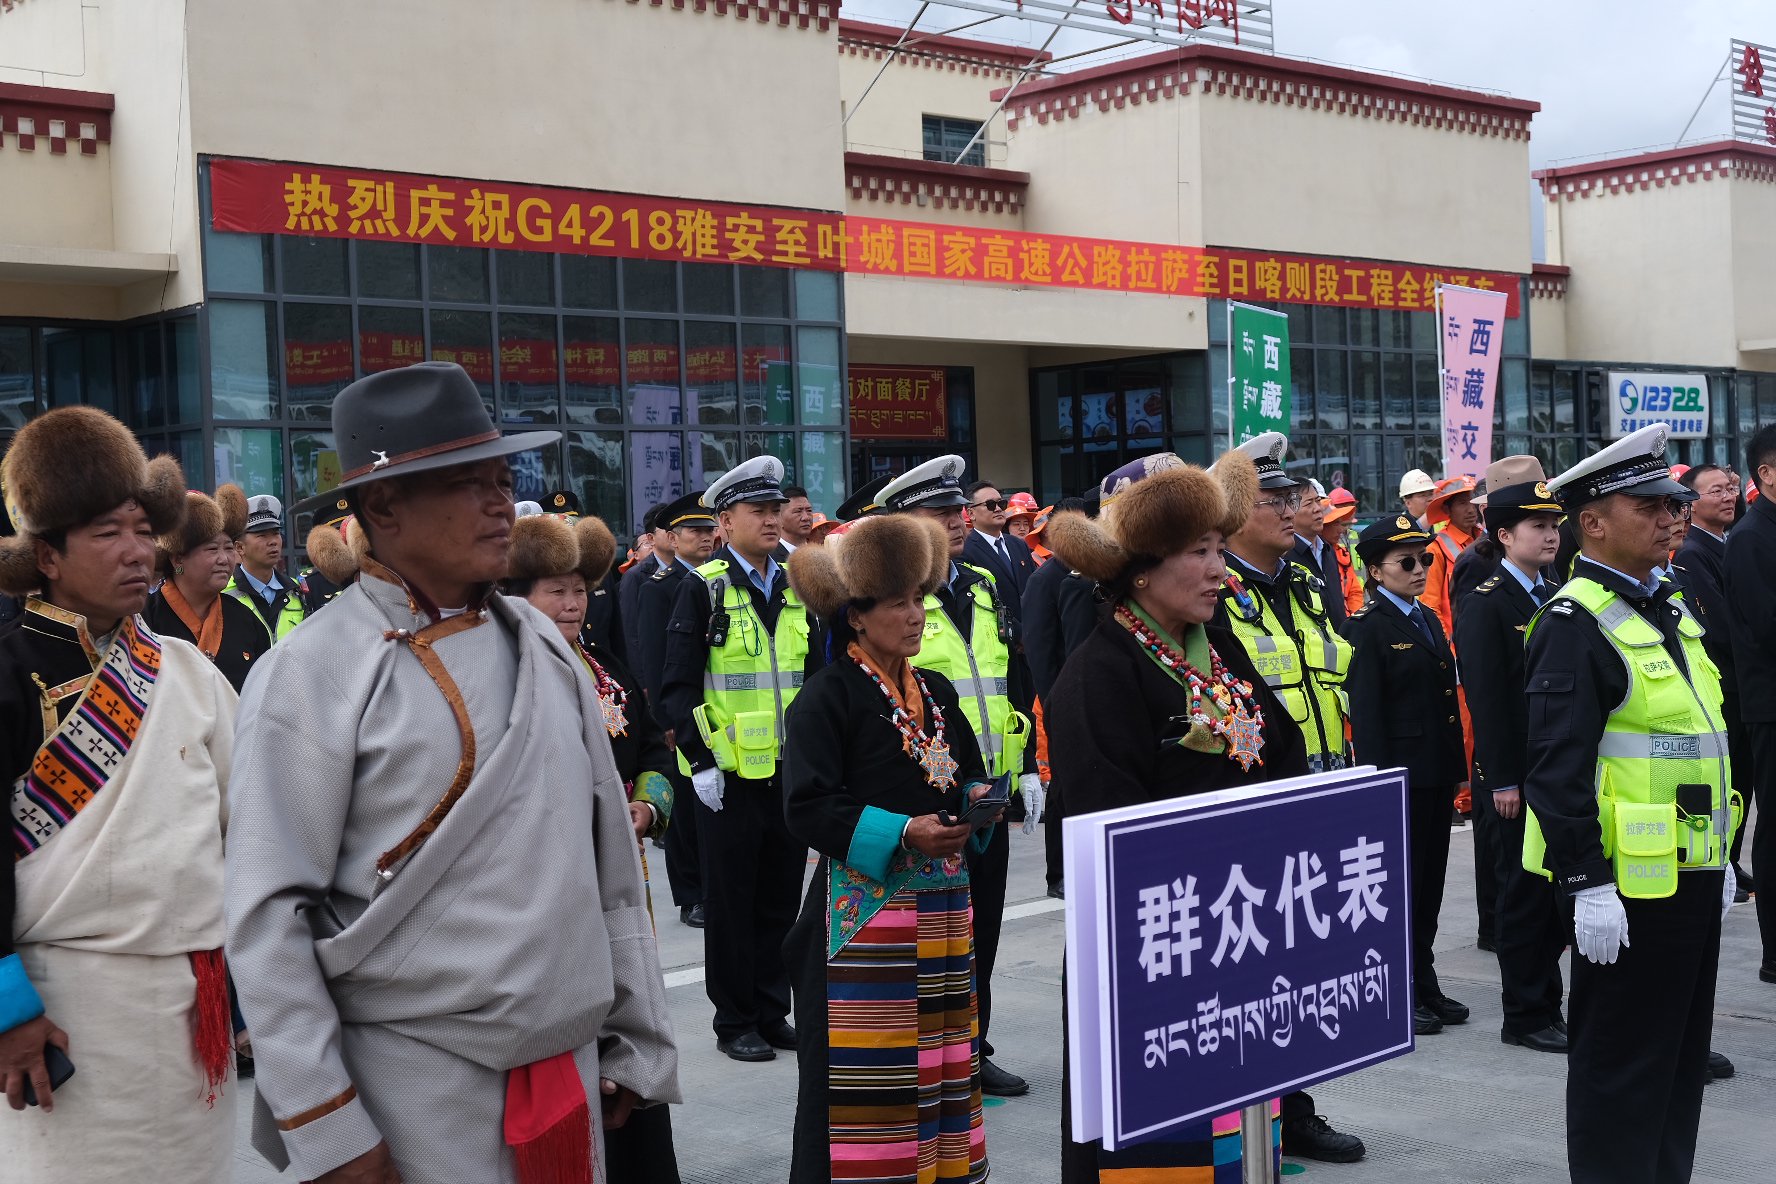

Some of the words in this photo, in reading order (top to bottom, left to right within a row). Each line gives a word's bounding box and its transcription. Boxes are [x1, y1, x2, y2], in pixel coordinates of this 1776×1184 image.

[1260, 334, 1282, 434] 西藏
[1461, 318, 1494, 479] 西藏交
[1641, 386, 1704, 411] 12328
[1654, 740, 1696, 752] POLICE
[745, 754, 770, 766] POLICE
[1626, 821, 1666, 836] 拉萨交警
[1568, 874, 1588, 884] POLICE
[1627, 863, 1669, 880] POLICE
[1138, 836, 1389, 982] 群众代表
